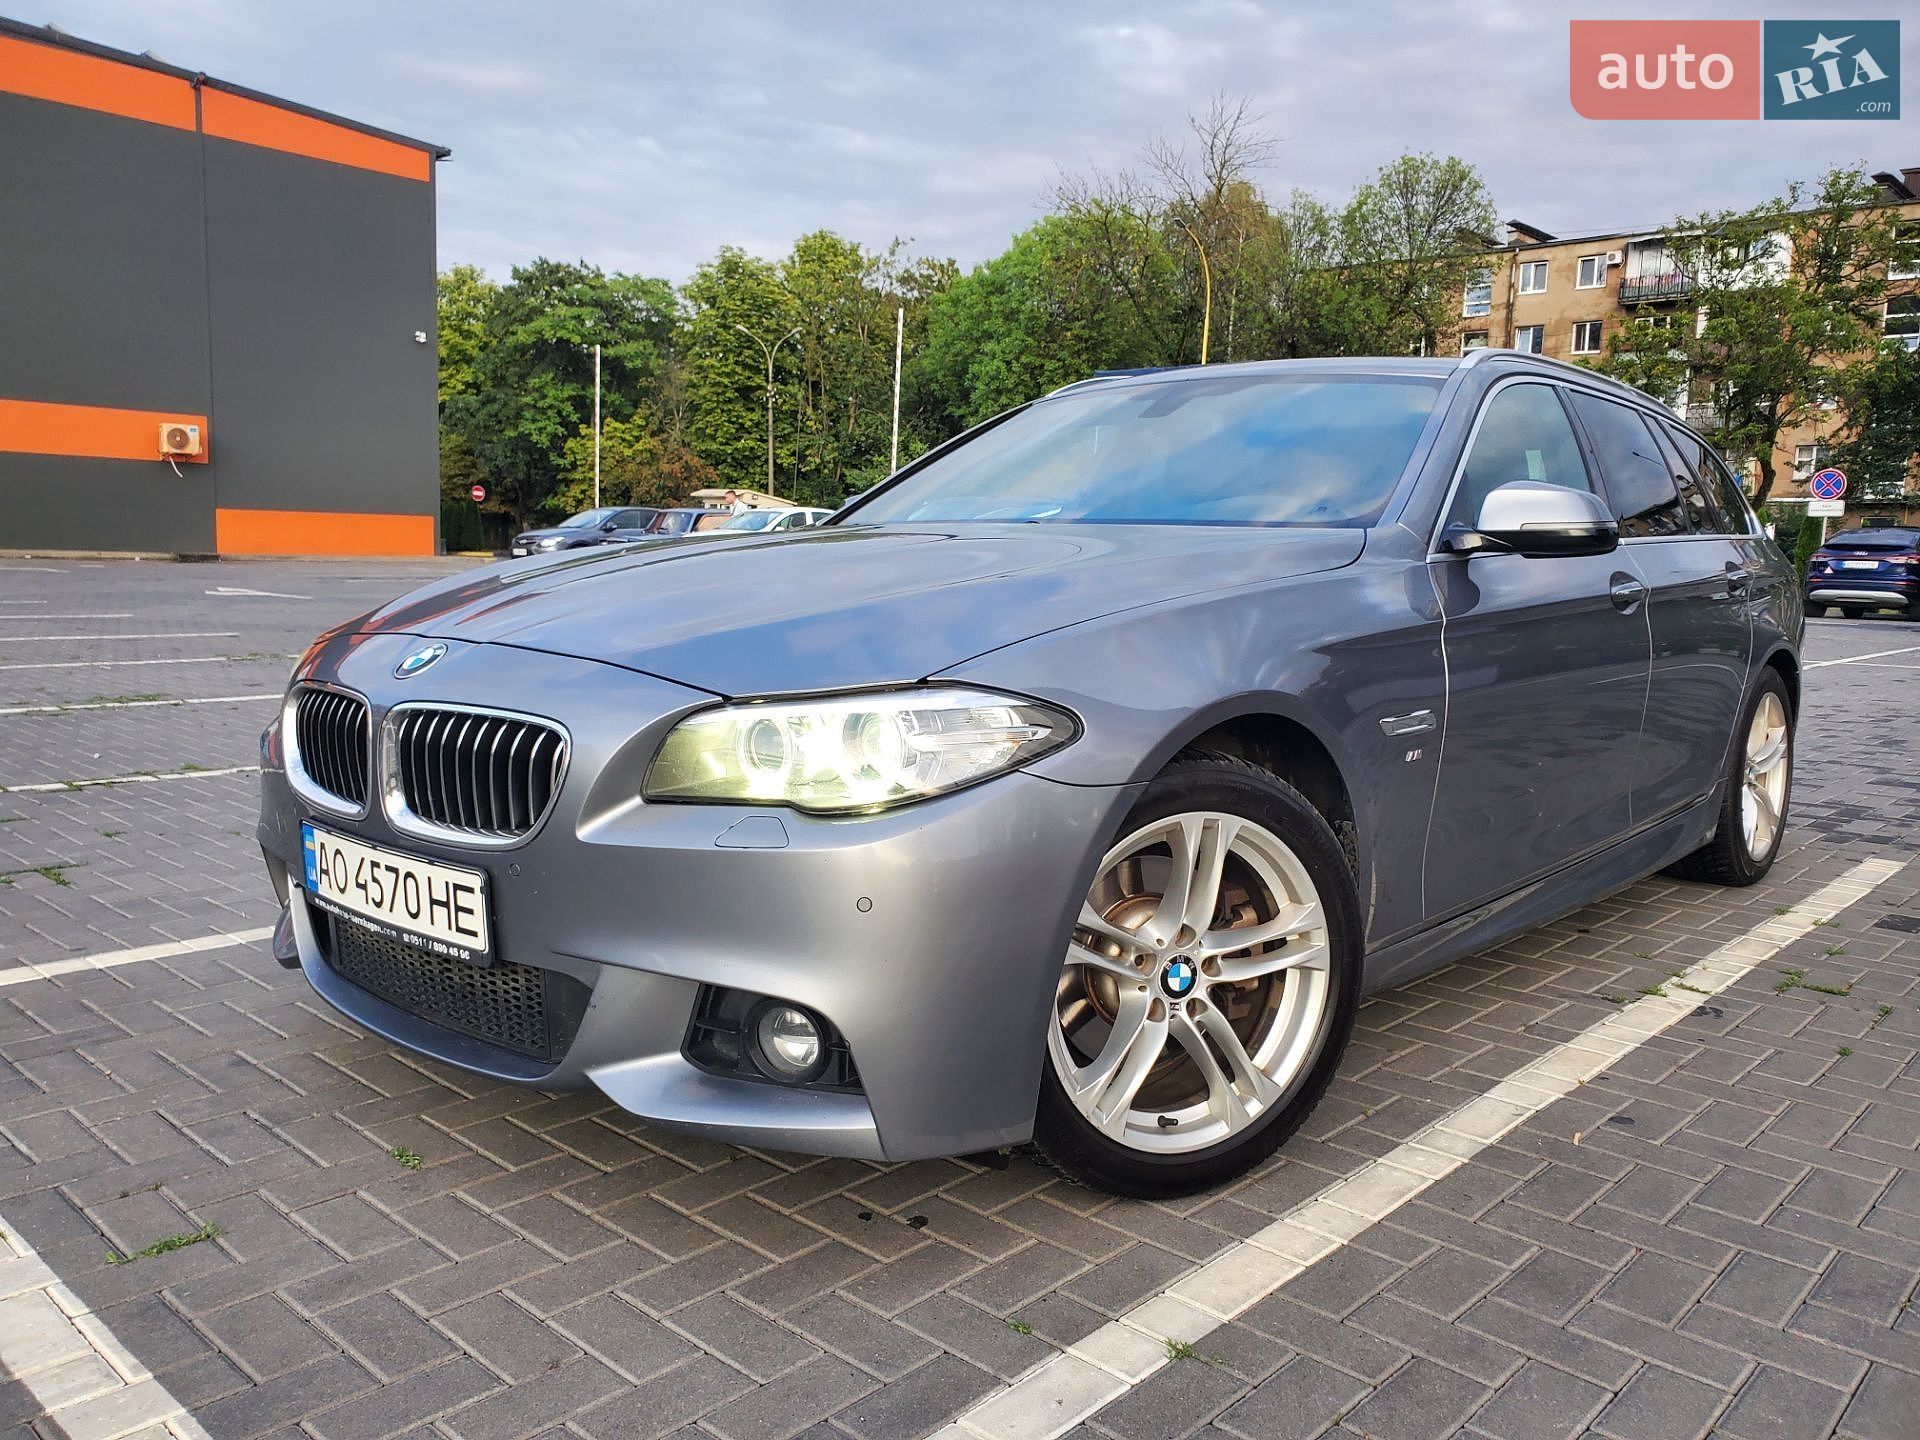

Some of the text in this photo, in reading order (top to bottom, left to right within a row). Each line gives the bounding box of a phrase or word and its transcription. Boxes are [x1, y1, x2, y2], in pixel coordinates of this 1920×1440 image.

[319, 842, 478, 938] AO 4570 HE
[1164, 955, 1196, 970] BMW
